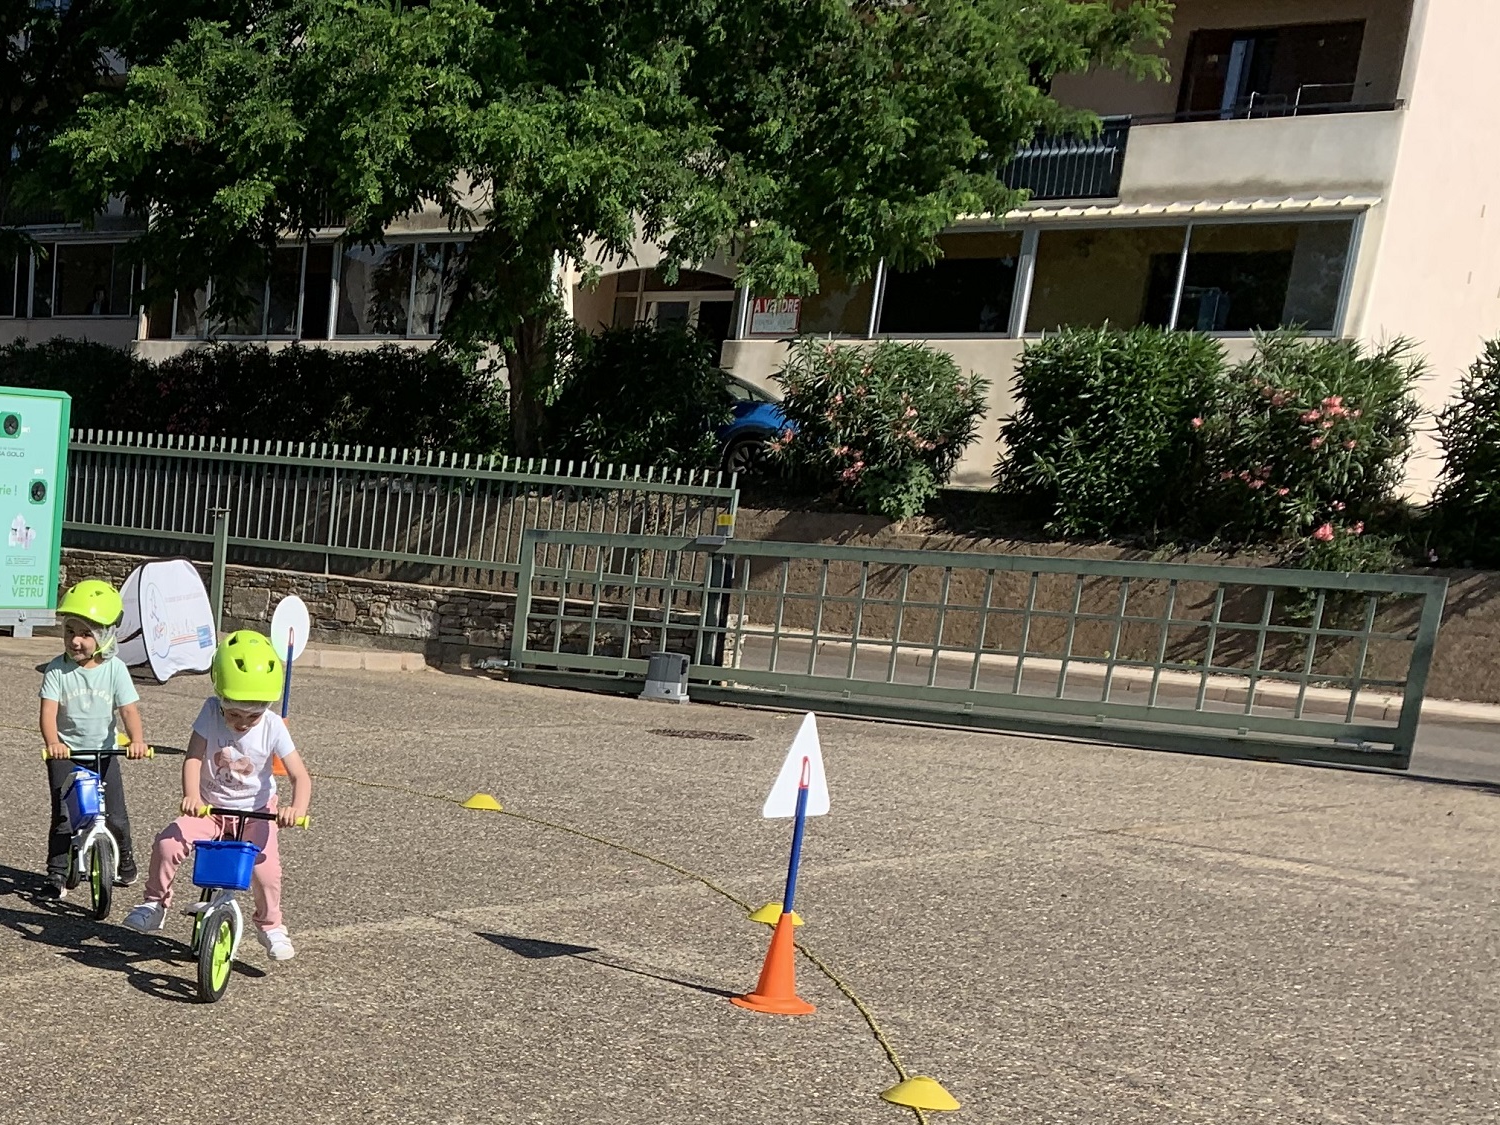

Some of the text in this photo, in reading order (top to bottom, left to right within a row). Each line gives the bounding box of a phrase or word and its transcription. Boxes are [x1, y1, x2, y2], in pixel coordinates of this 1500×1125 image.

[754, 299, 800, 312] A VDRE
[12, 575, 45, 586] VERRE
[11, 587, 44, 598] VETRU
